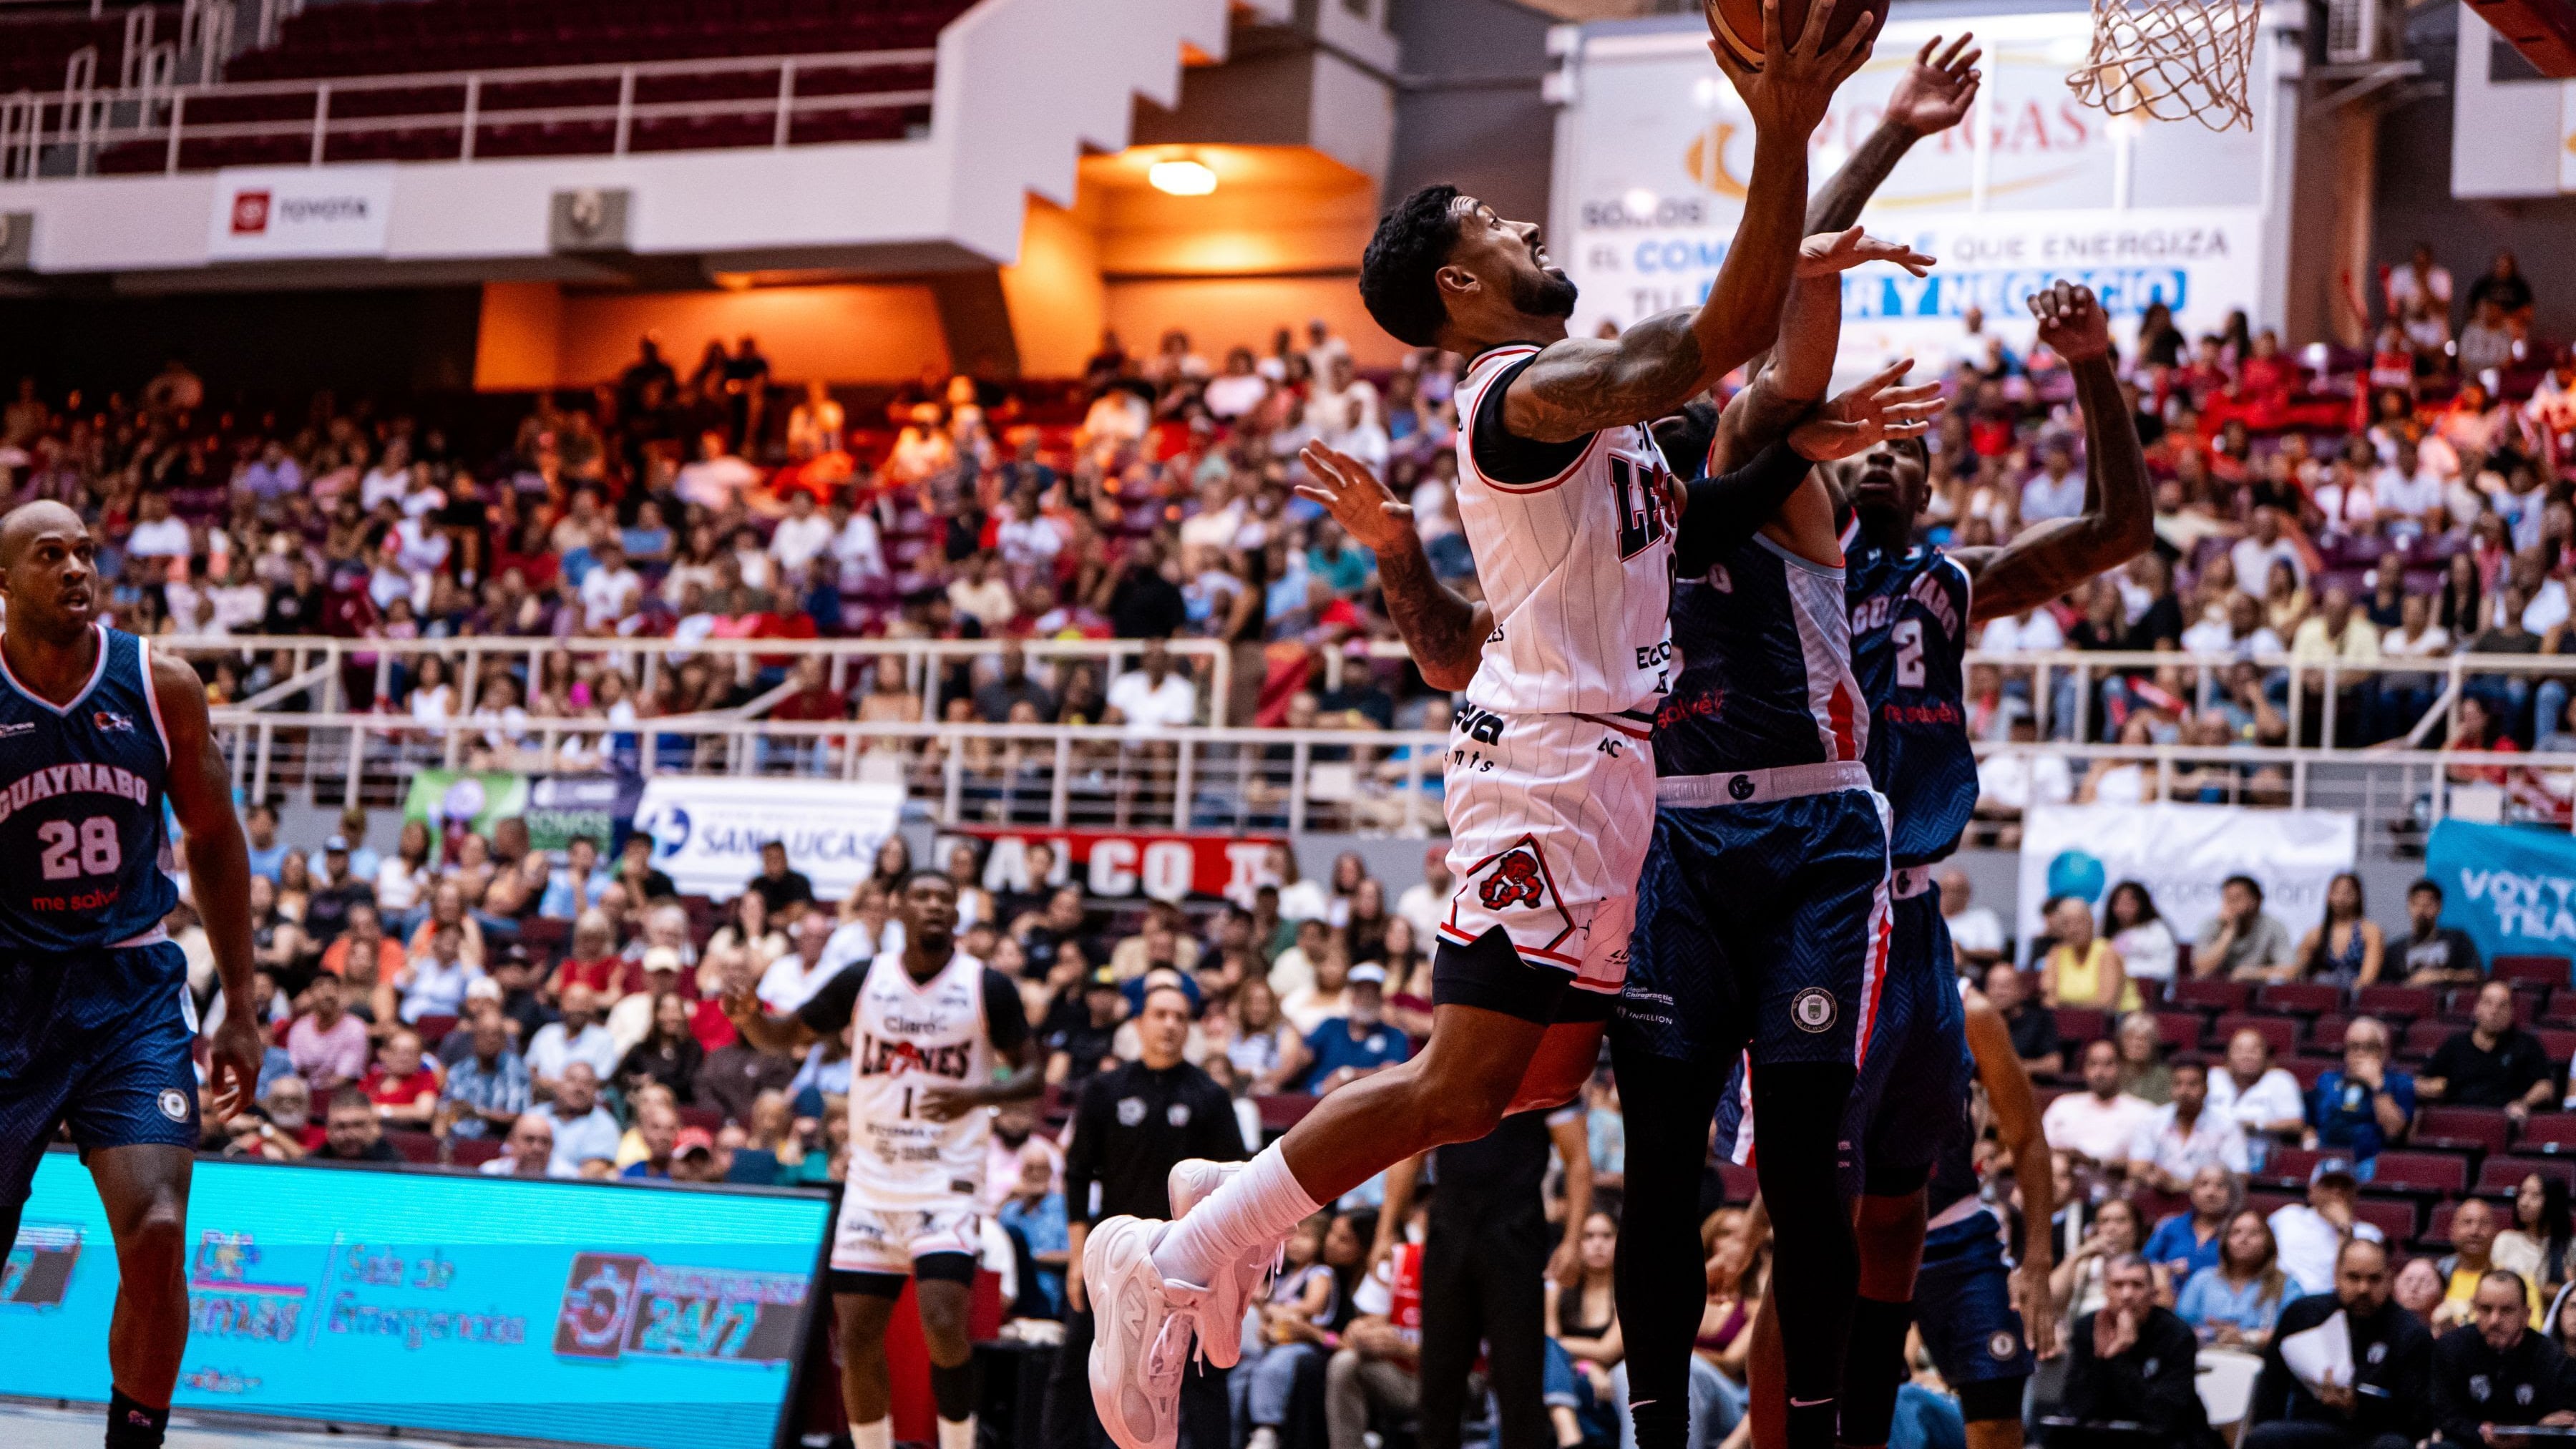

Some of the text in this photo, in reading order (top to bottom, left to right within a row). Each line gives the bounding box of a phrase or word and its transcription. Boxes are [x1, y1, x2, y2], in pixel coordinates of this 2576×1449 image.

[1581, 200, 1700, 228] SOOS
[1952, 235, 2026, 262] QUE
[2043, 228, 2229, 259] ENERGIZA
[1891, 618, 1926, 689] 2
[37, 815, 122, 880] 28
[32, 896, 65, 911] me
[1626, 992, 1673, 1002] Chiropractic
[1629, 1012, 1672, 1025] INFILLION
